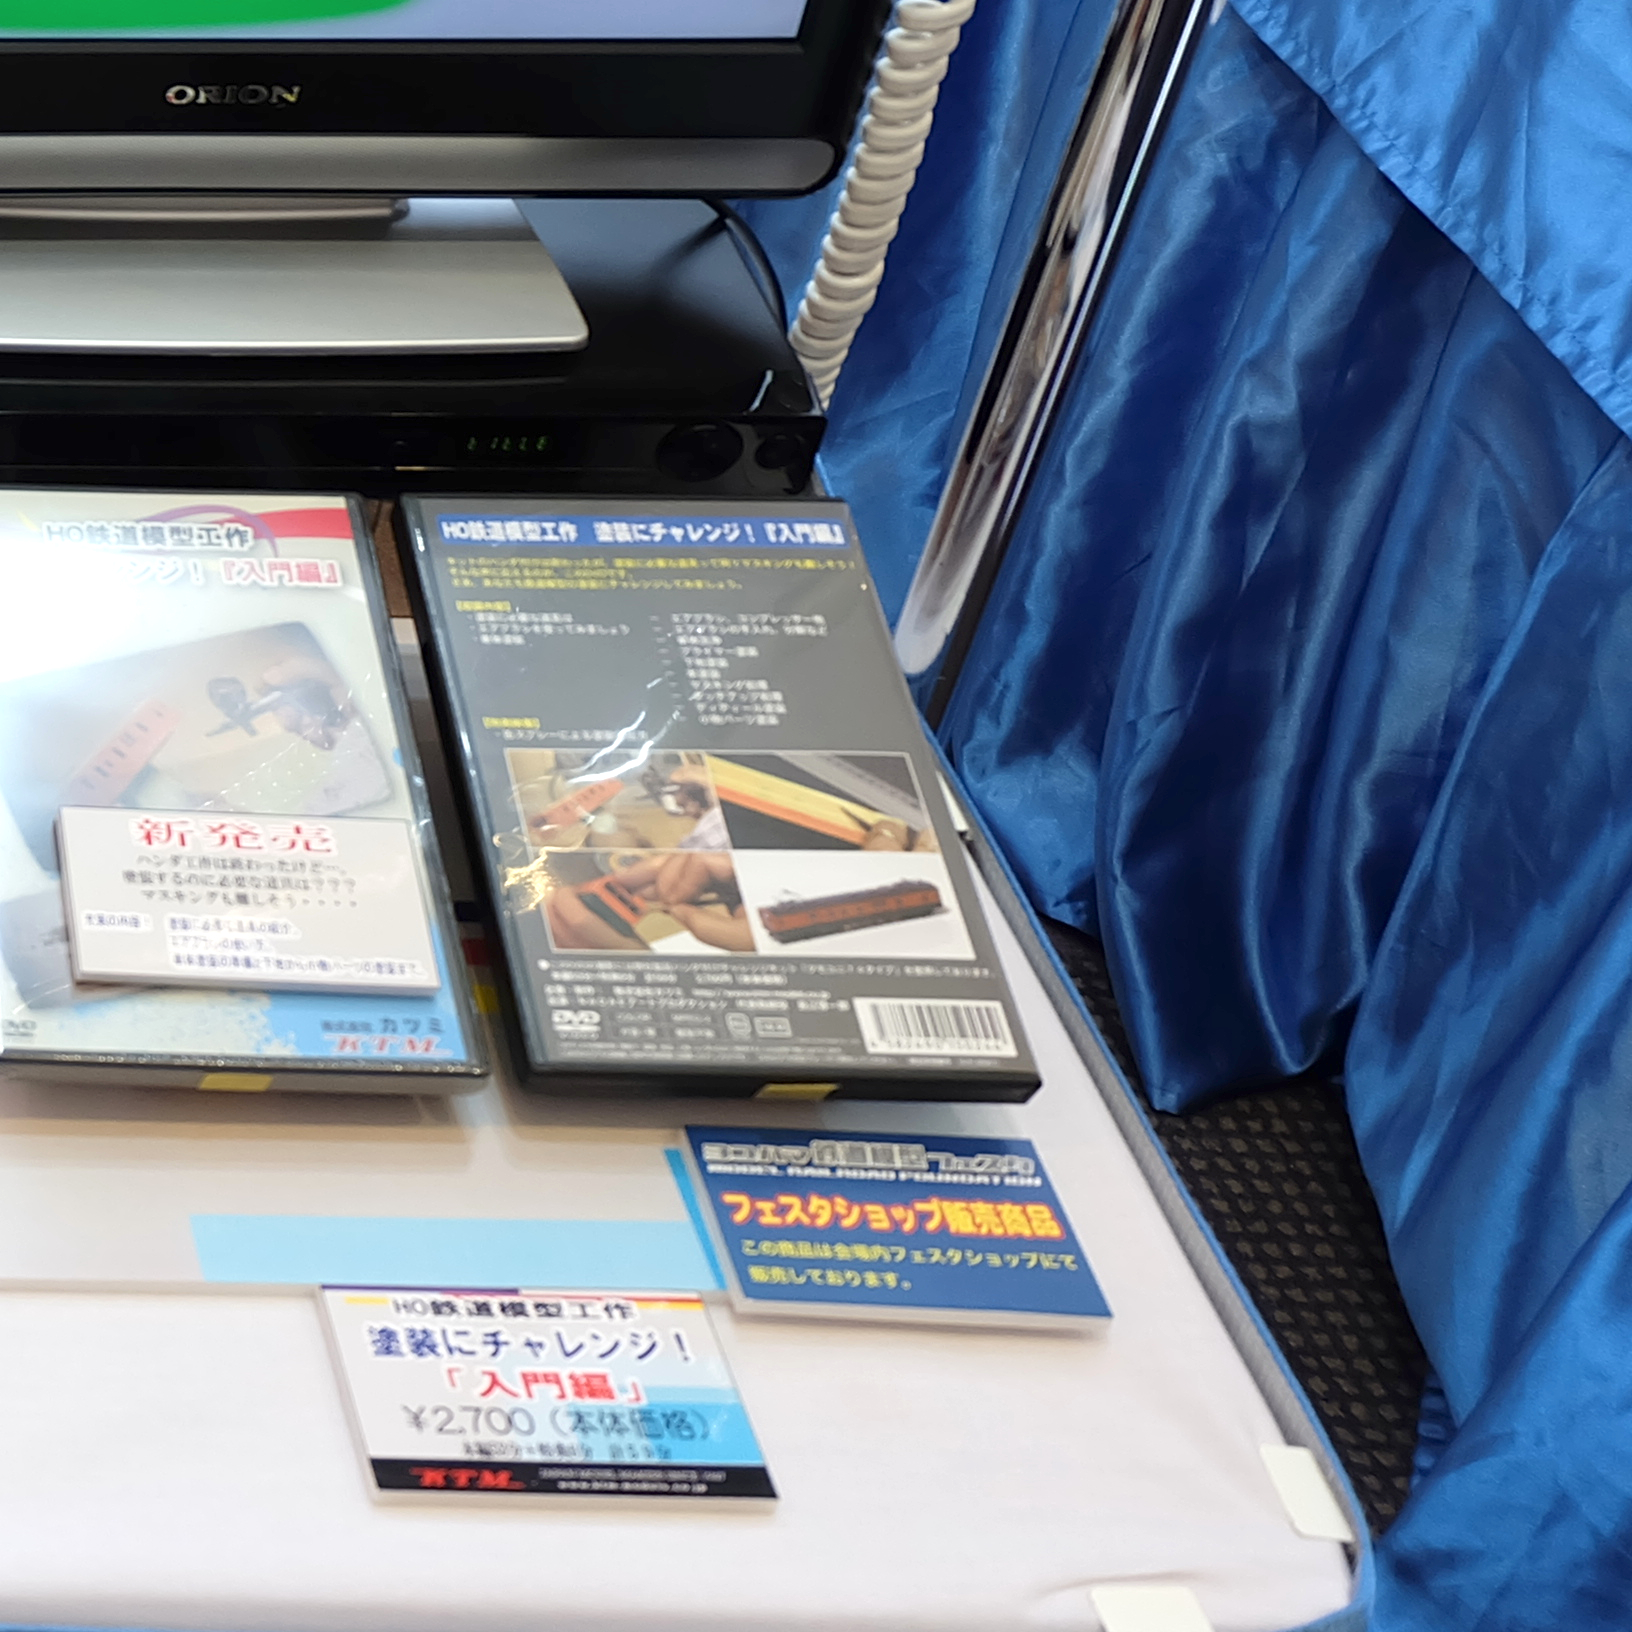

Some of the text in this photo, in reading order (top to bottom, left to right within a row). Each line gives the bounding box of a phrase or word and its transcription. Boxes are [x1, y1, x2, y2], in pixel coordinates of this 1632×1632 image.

[163, 80, 302, 107] ORION
[135, 818, 335, 854] 新発売
[719, 1191, 1065, 1239] フェスタショップ販売商品
[367, 1325, 695, 1363] 塗装にチャレンジ！
